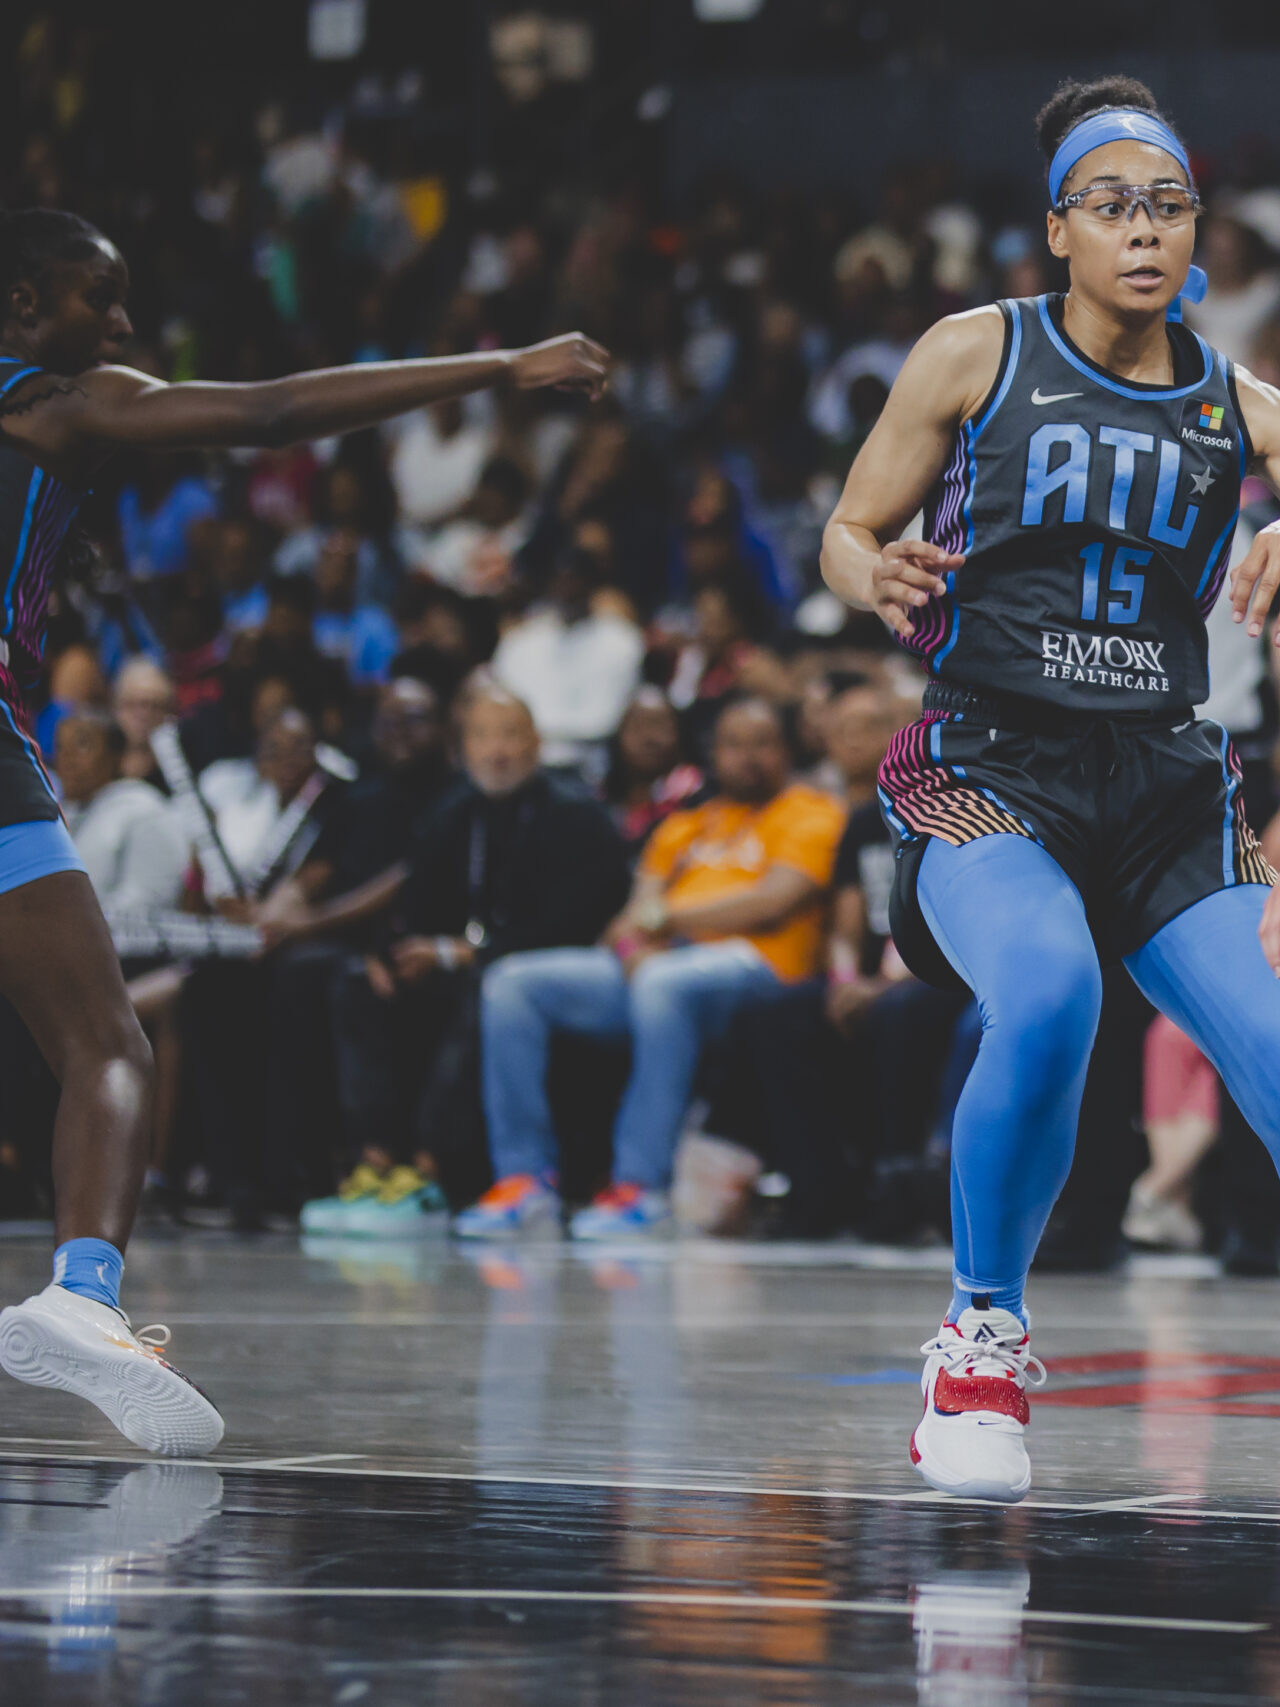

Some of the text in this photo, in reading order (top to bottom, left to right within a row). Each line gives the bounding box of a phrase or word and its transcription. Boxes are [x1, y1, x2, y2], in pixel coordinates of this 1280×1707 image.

[1181, 427, 1232, 450] Microsoft
[1021, 423, 1199, 549] ATL
[1079, 542, 1153, 624] 15
[1040, 631, 1166, 673] EMORY
[1043, 663, 1169, 692] HEALTHCARE
